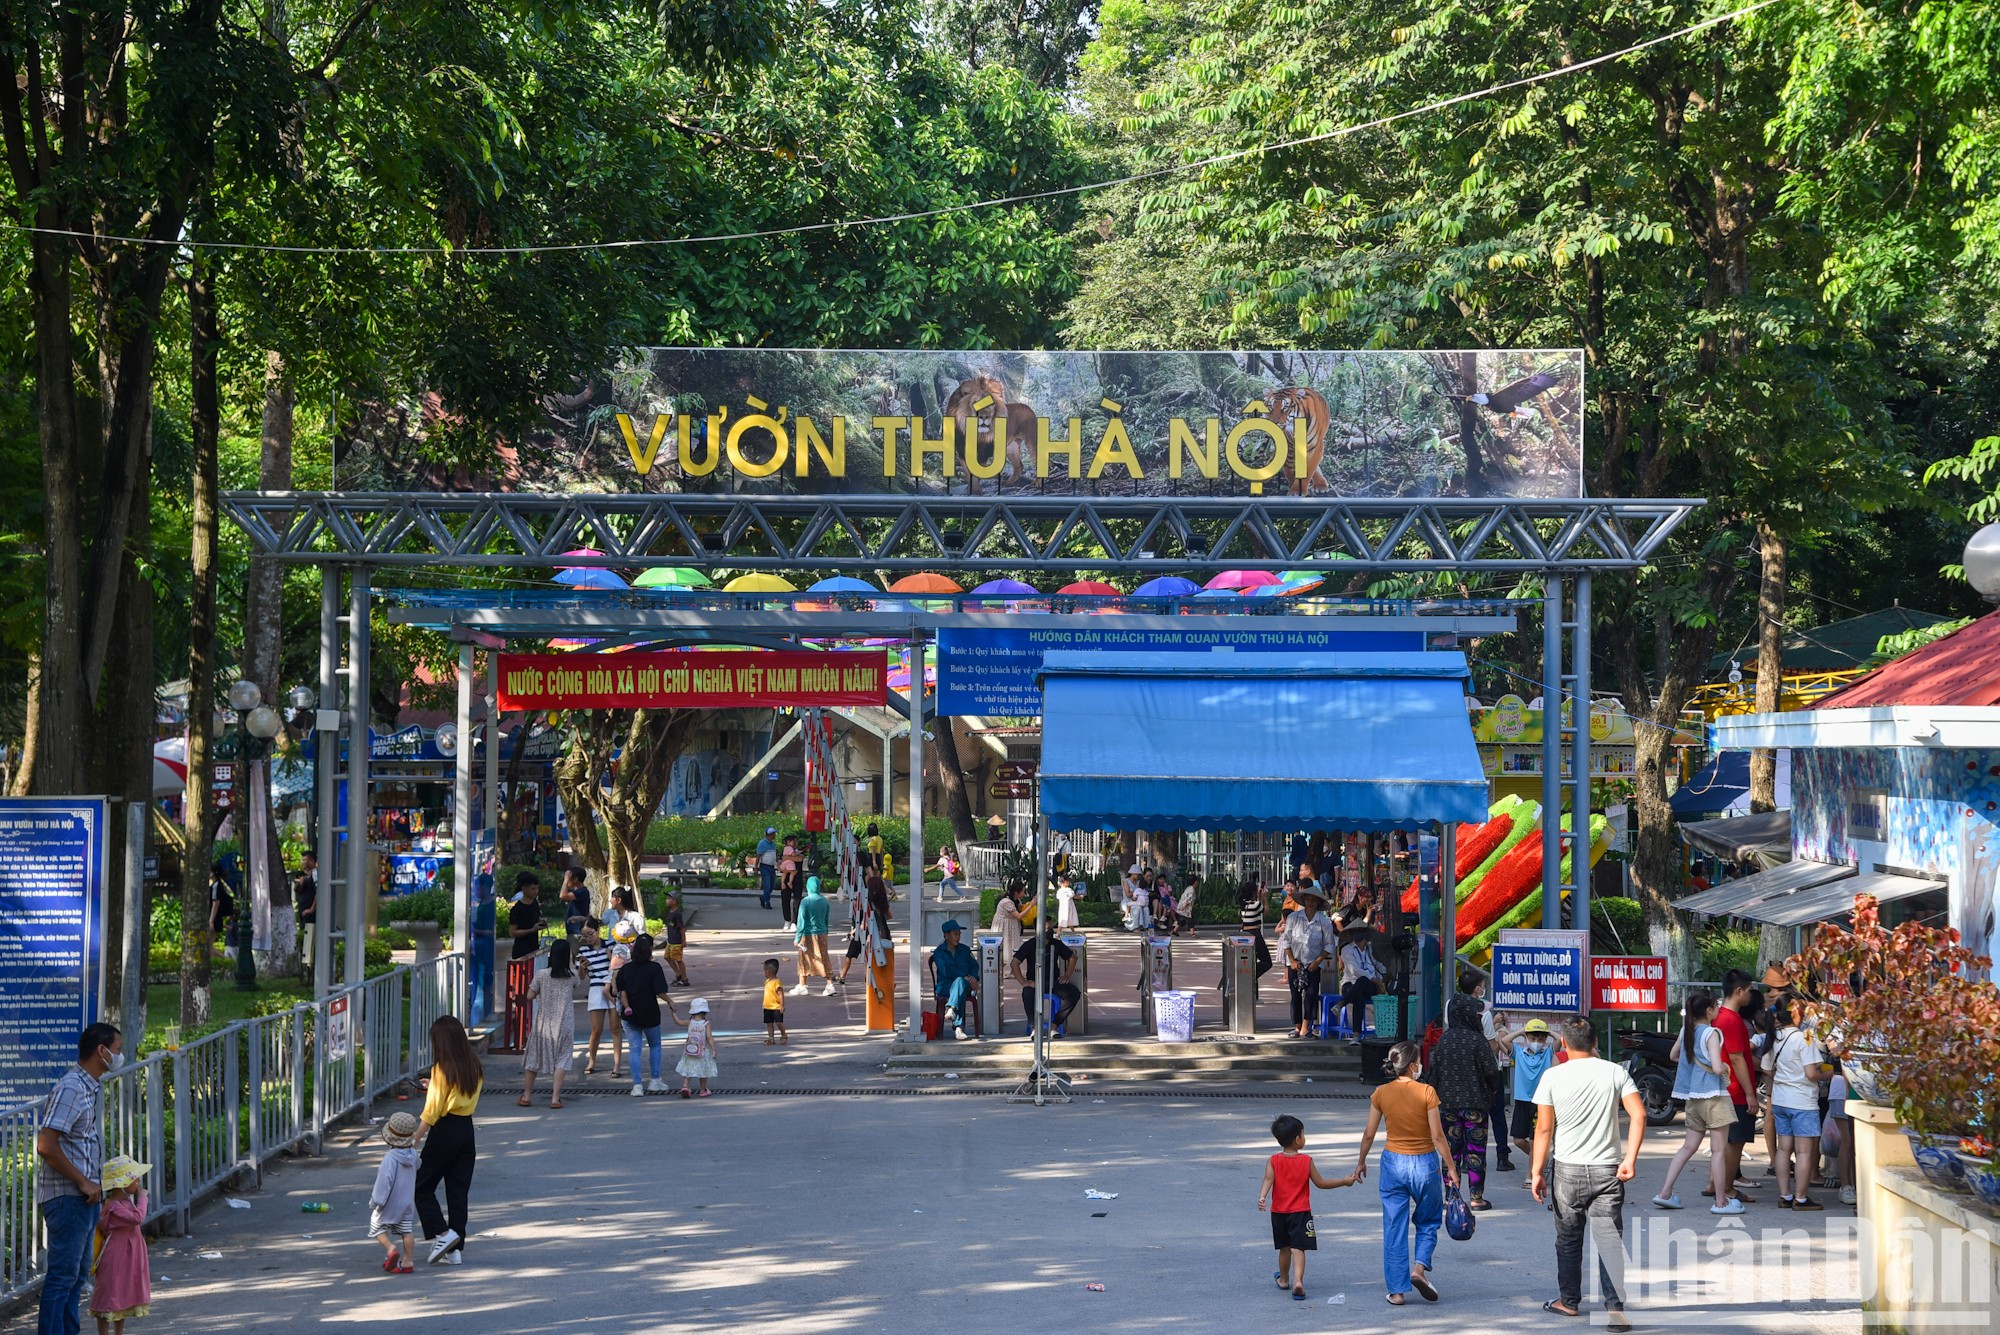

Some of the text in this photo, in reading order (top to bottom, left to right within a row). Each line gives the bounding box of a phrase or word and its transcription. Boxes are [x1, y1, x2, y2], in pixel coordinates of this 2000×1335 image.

[615, 395, 1308, 495] VƯỜN THÚ HÀ NỘI
[1029, 630, 1328, 647] HƯỚNG DẪN KHÁCH THAM QUAN VƯỜN THÚ HÀ NỘI
[950, 646, 967, 655] Bước
[968, 647, 974, 655] 1:
[508, 661, 878, 700] NƯỚC CỘNG HÒA XÃ HỘI CHỦ NGHĨA VIỆT NAM MUÔN NĂM!
[14, 819, 74, 831] VƯỜN THÚ HÀ NỘI
[1501, 953, 1512, 965] XE
[1514, 953, 1532, 965] TAXI
[1503, 969, 1570, 986] ĐÓN TRẢ KHÁCH
[1594, 959, 1612, 979] CẤM
[1631, 960, 1646, 979] THẢ
[1647, 962, 1663, 979] CHÓ
[1495, 990, 1525, 1004] KHÔNG
[1527, 990, 1545, 1006] QUÁ
[1546, 993, 1552, 1005] 5
[1601, 985, 1656, 1003] VÀO VƯỜN THÚ
